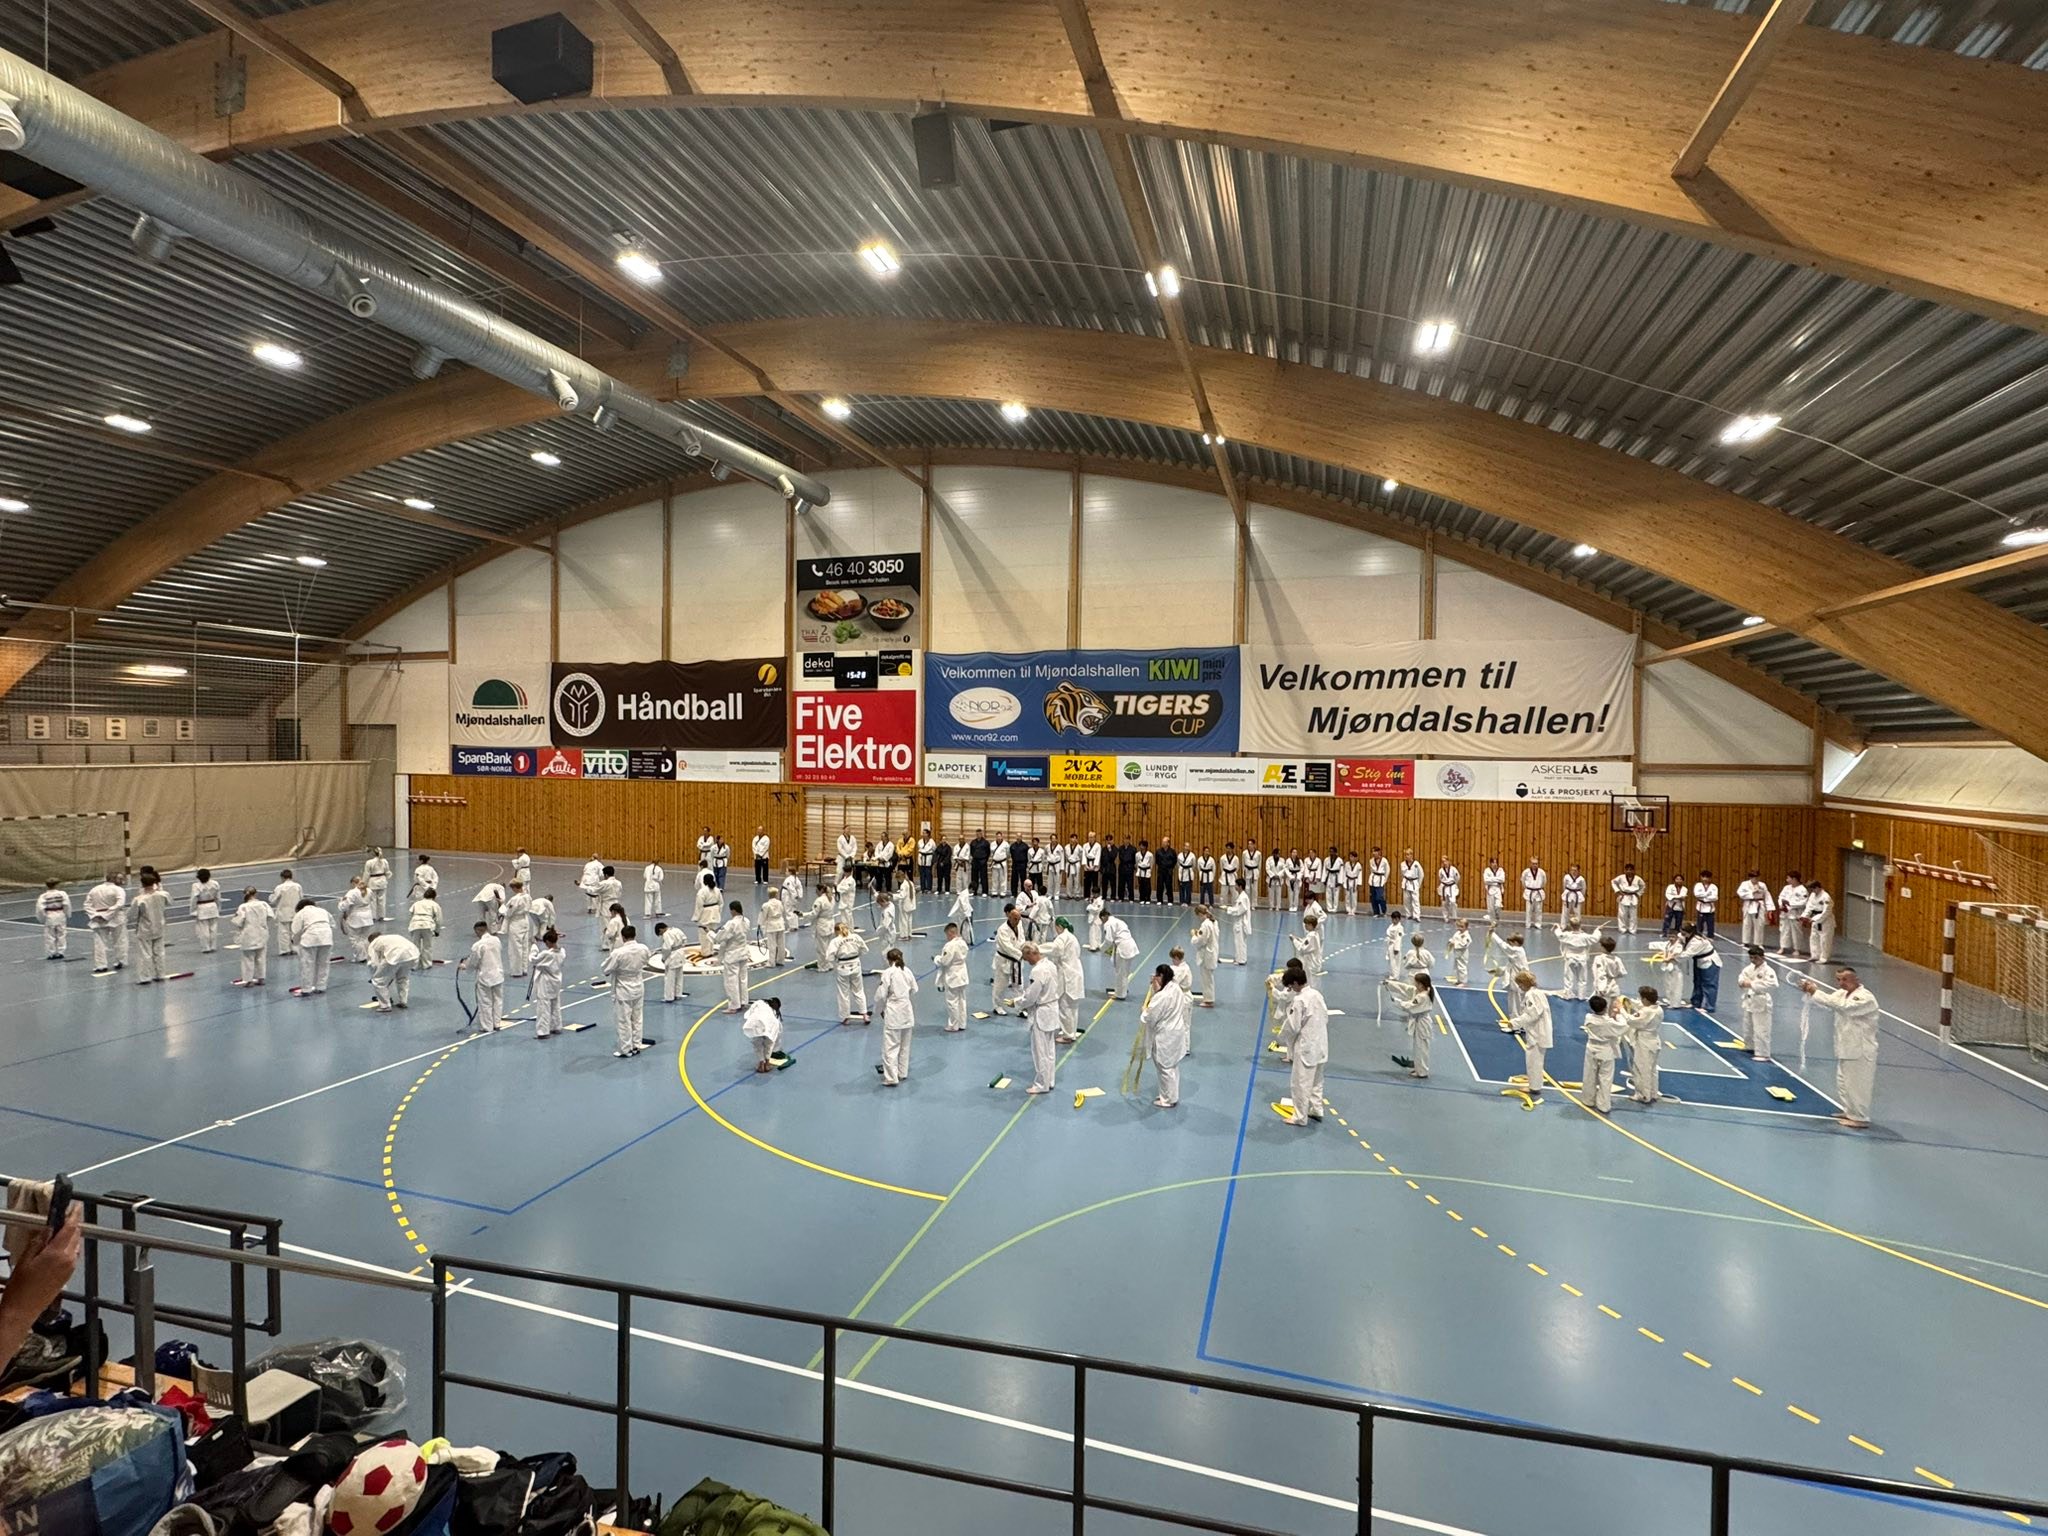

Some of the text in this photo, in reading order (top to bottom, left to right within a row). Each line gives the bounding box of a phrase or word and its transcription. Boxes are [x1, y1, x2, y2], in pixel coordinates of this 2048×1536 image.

[825, 558, 905, 577] 46 40 3050
[821, 624, 828, 636] 2
[804, 657, 834, 669] dekal
[1148, 657, 1200, 681] KIWI
[1202, 657, 1225, 669] mini
[940, 663, 1140, 680] Velkommen til Mjøndalshallen
[1202, 670, 1222, 683] pris
[1259, 661, 1517, 691] Velkommen til
[617, 691, 743, 721] Håndball
[1113, 694, 1211, 716] TIGERS
[455, 713, 545, 728] Mjøndalshallen
[796, 696, 863, 731] Five
[1170, 718, 1205, 735] CUP
[1307, 704, 1611, 741] Mjøndalshallen!
[950, 732, 1019, 742] www.nor92.com
[458, 751, 513, 765] SpareBank
[796, 735, 913, 771] Elektro
[583, 750, 628, 774] vito
[938, 764, 977, 773] APOTEK
[1145, 764, 1178, 772] LUNDBY
[1531, 764, 1598, 775] ASKER LÅS
[1353, 766, 1381, 782] Stig
[1531, 786, 1547, 795] LÅS
[1558, 788, 1600, 796] PROSJEKT
